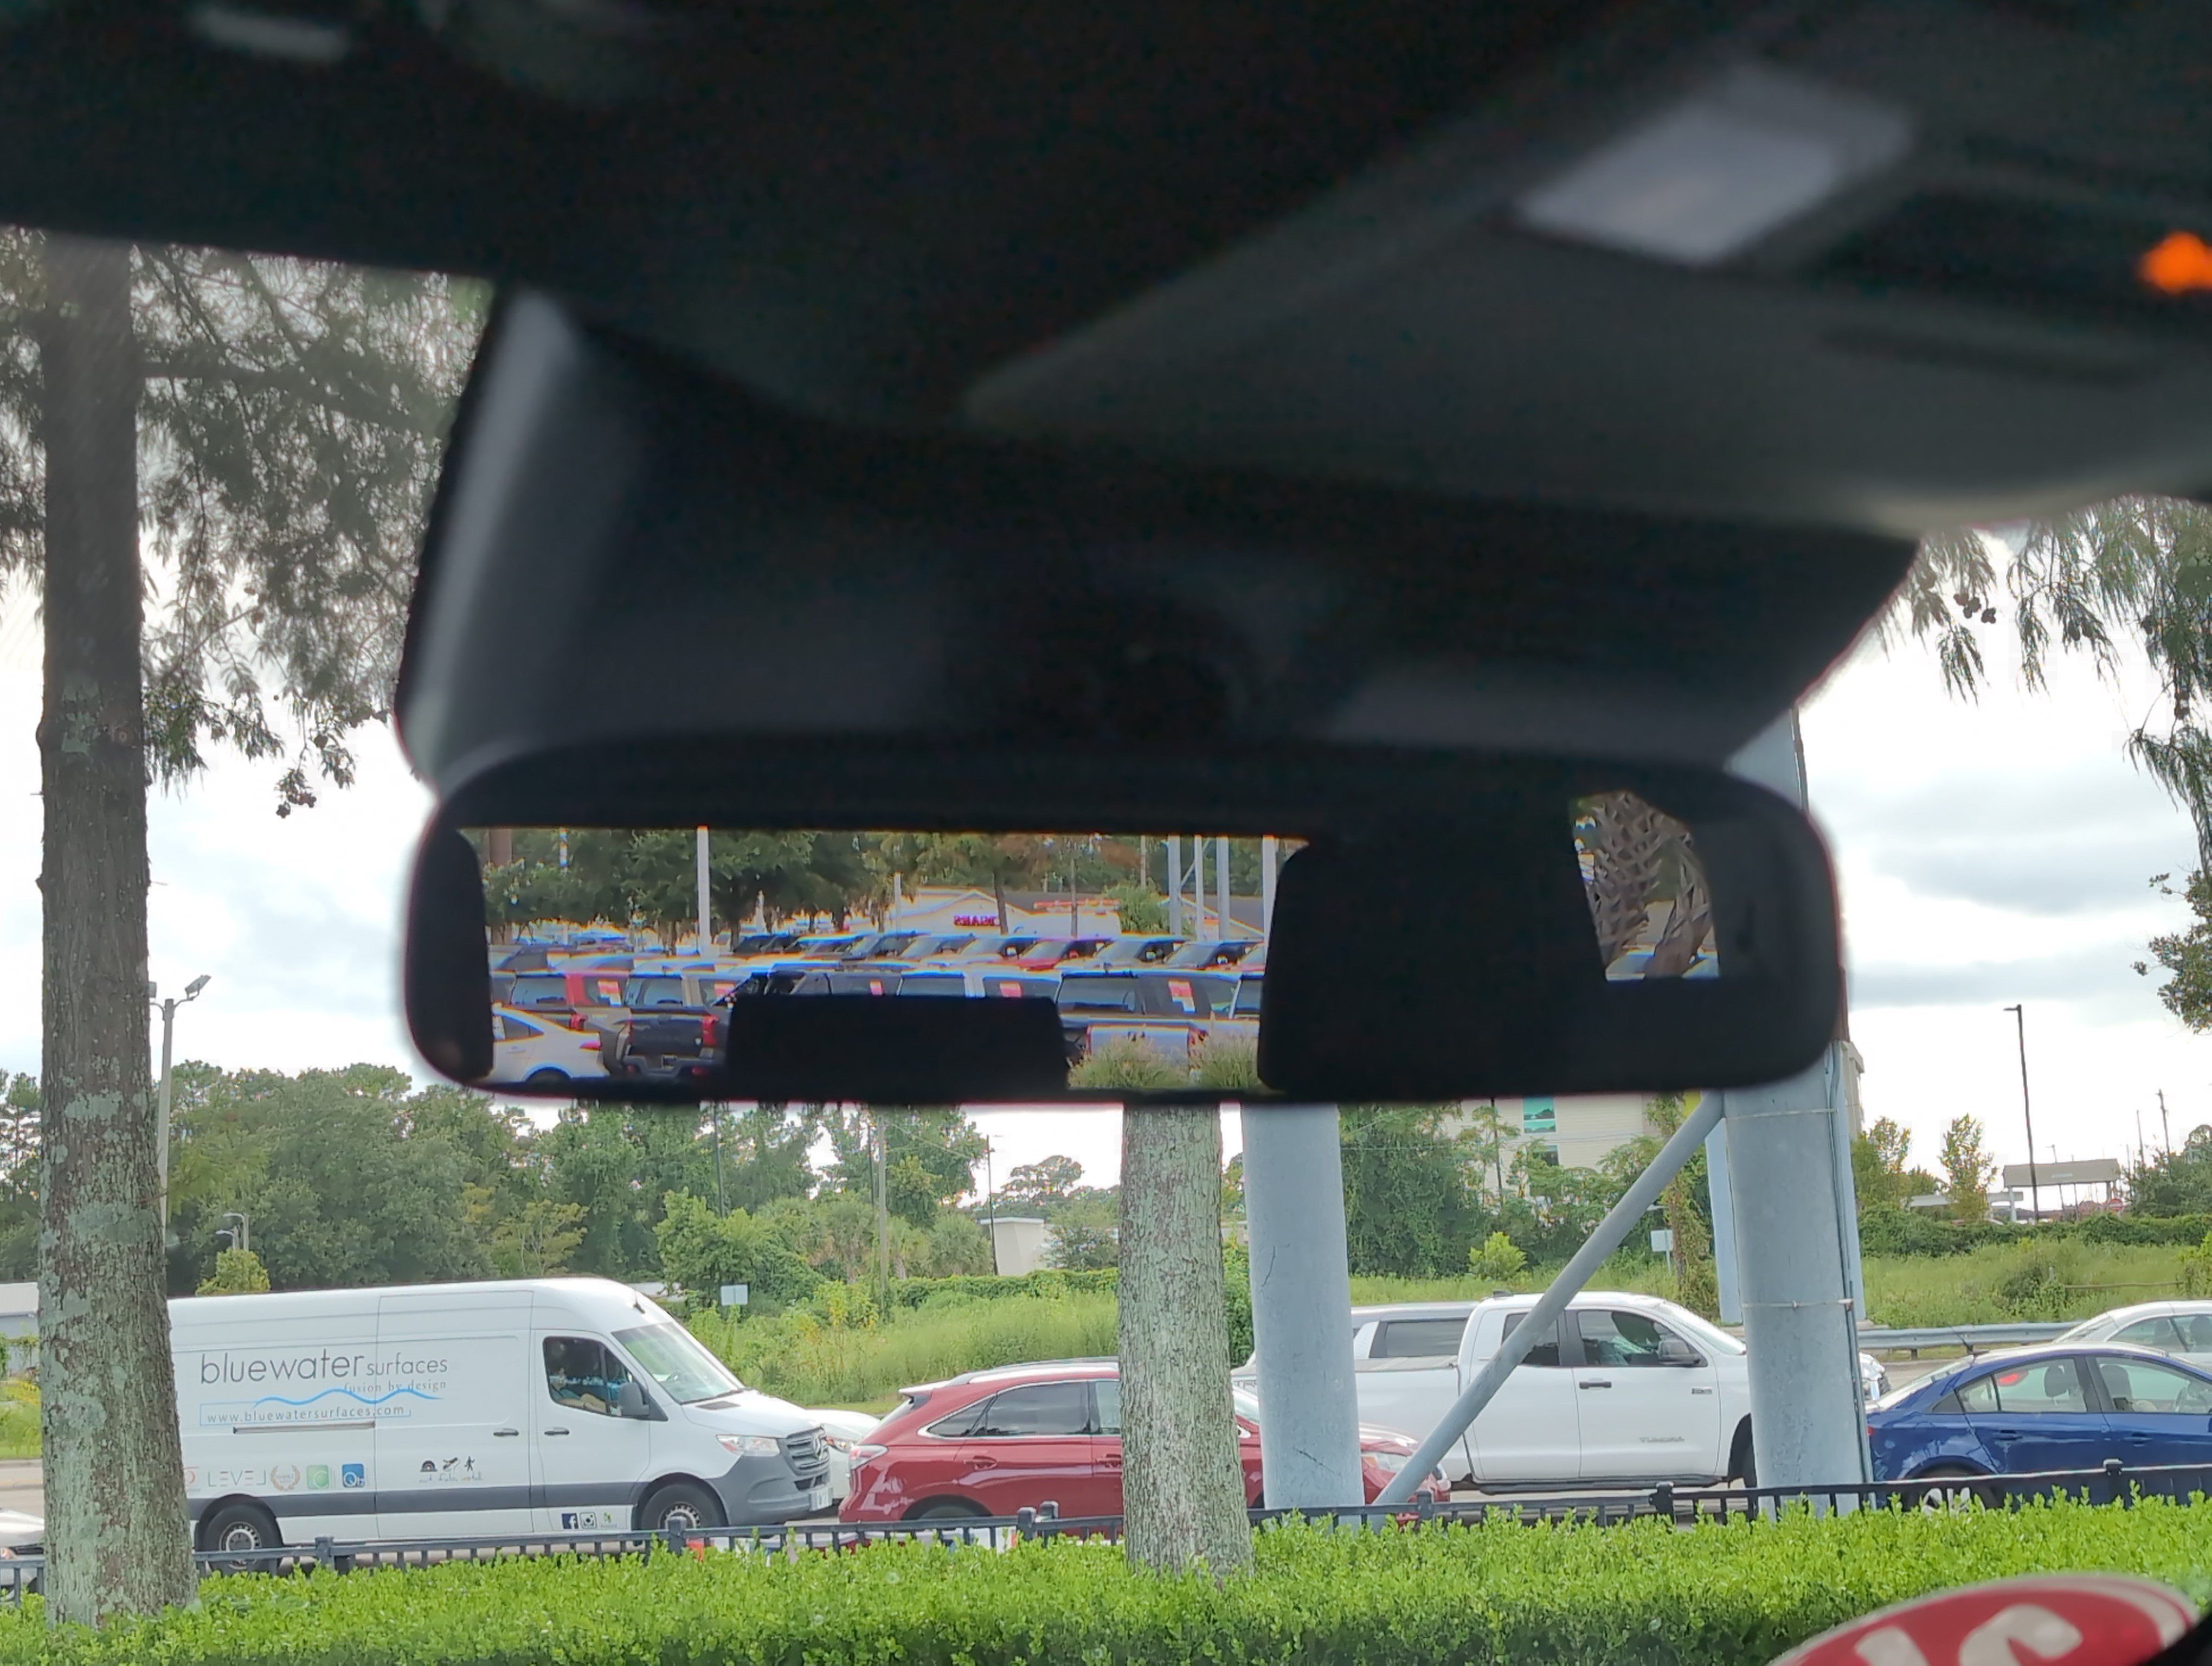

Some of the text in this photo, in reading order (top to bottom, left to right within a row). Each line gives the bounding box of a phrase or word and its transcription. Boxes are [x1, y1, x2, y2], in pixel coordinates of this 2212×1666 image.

[201, 1348, 448, 1383] bluewater surfaces
[344, 1382, 382, 1393] fusion
[408, 1379, 446, 1392] design
[207, 1406, 404, 1423] www.bluewatersurfaces.com
[208, 1469, 266, 1487] LEVEL
